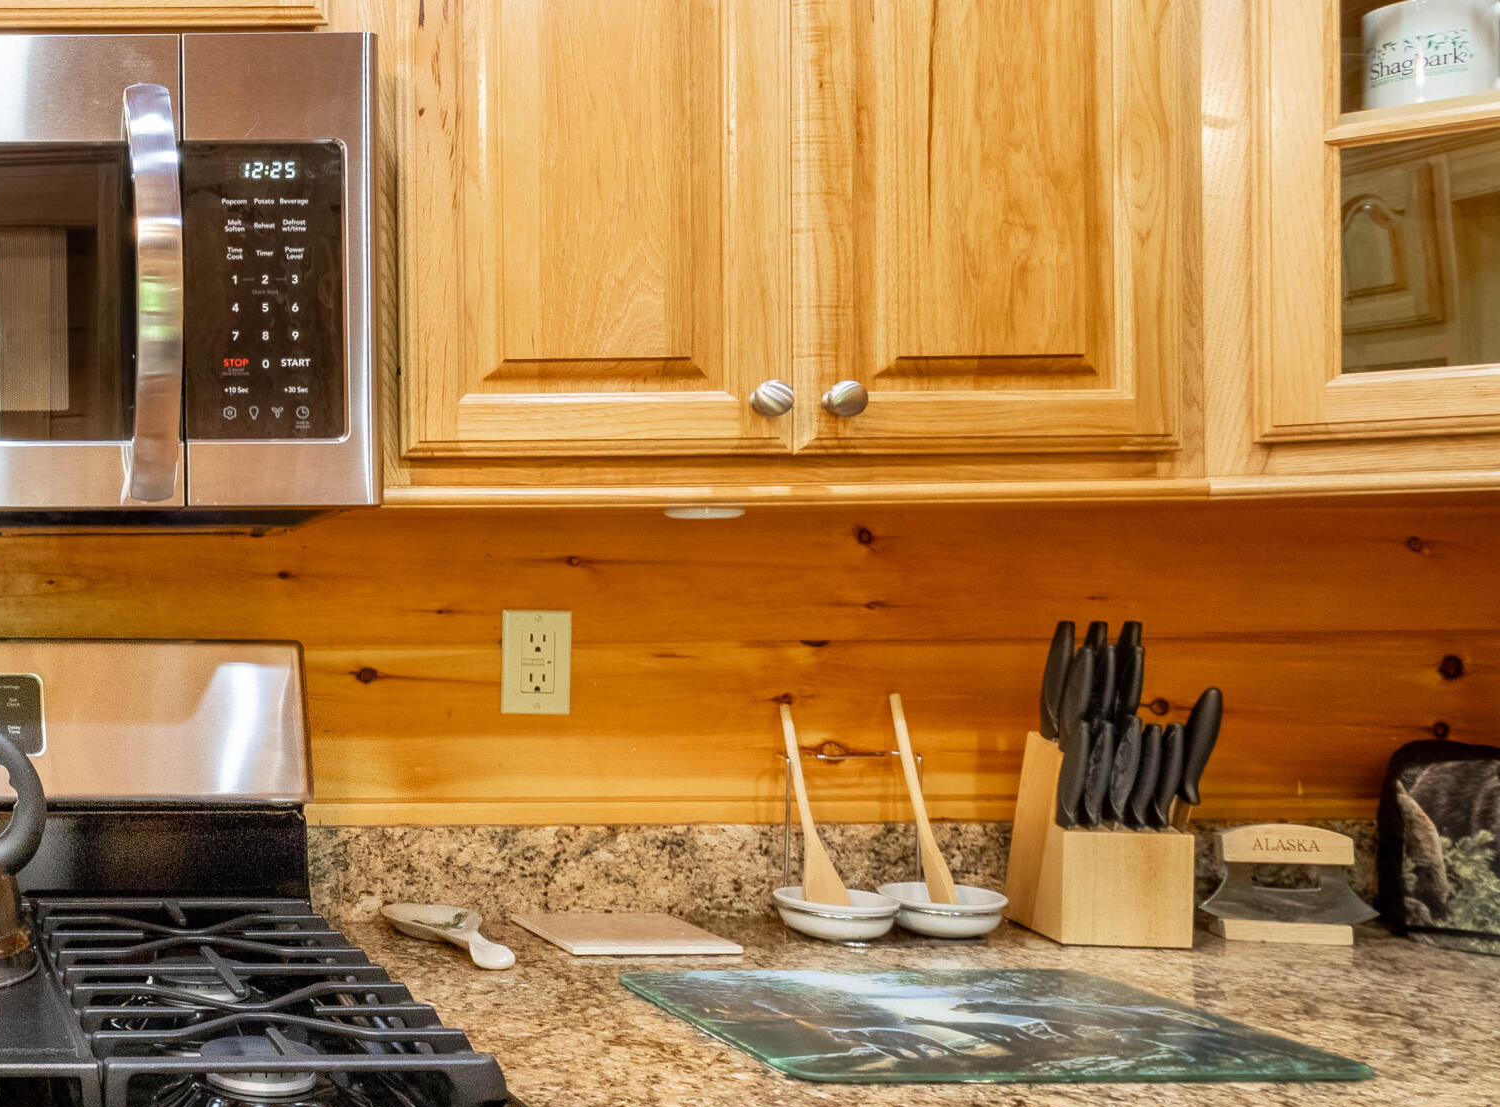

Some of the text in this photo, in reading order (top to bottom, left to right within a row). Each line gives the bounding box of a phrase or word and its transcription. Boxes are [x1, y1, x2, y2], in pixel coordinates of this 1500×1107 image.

[243, 161, 297, 179] 12:25
[221, 198, 248, 206] Popcorn
[279, 198, 309, 206] Beverage
[253, 222, 276, 230] Reheat
[232, 275, 238, 285] 1
[261, 275, 269, 285] 2
[291, 275, 299, 285] 3
[232, 303, 240, 313] 4
[262, 303, 269, 313] 5
[291, 303, 299, 313] 6
[232, 331, 239, 341] 7
[262, 331, 269, 341] 8
[291, 331, 299, 341] 9
[223, 358, 249, 367] STOP
[262, 359, 270, 369] 0
[280, 358, 311, 367] START
[1252, 838, 1321, 853] ALASKA
